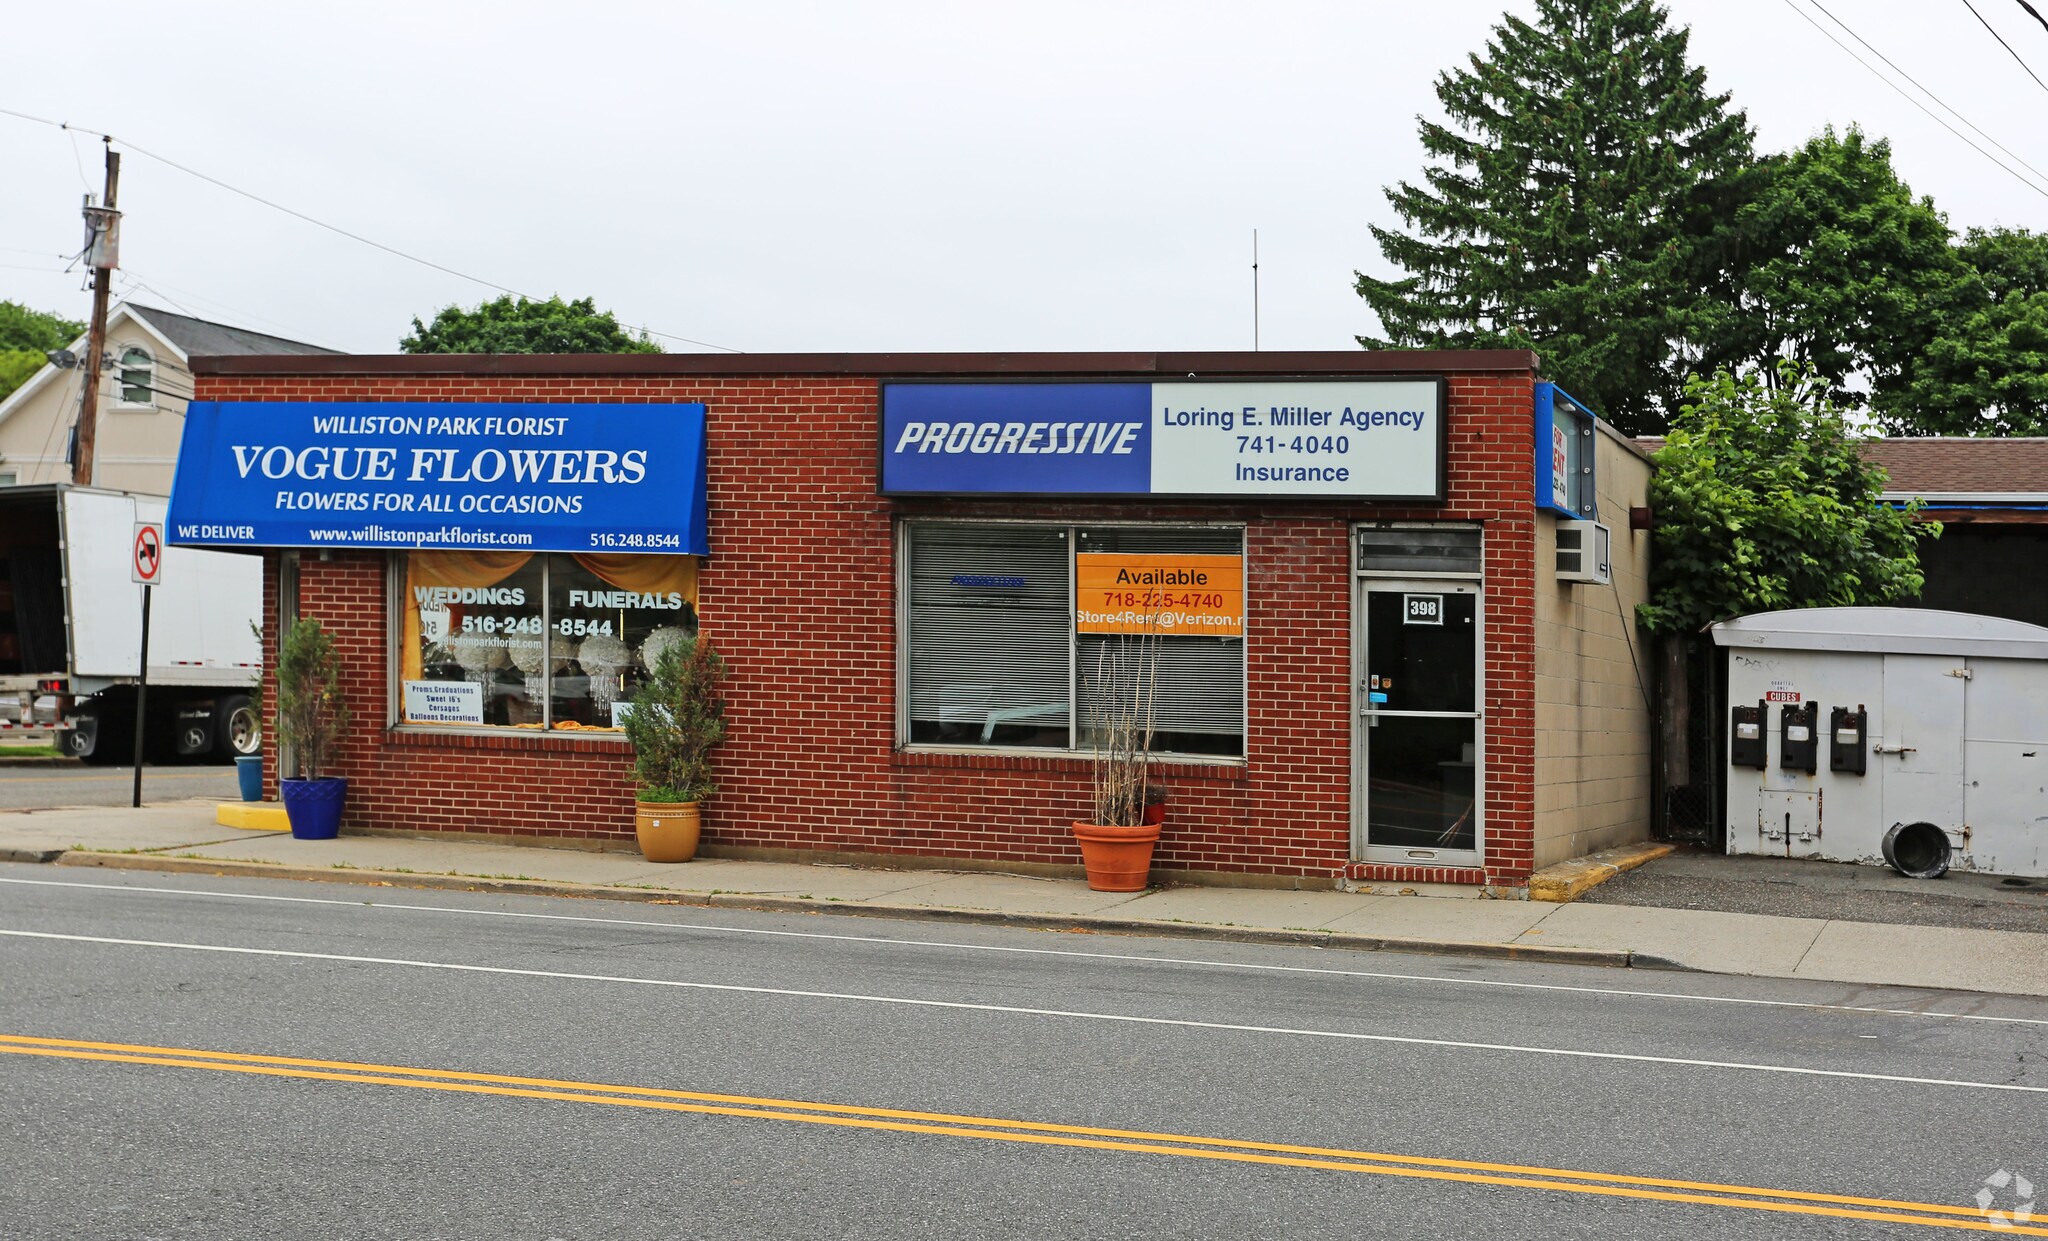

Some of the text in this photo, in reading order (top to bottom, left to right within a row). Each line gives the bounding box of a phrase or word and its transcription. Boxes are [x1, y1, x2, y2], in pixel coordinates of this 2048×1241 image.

[313, 416, 569, 436] WILLISTON PARK FLORIST
[1164, 407, 1425, 431] Loring E. Miller Agency
[894, 423, 1143, 454] PROGRESSIVE
[1236, 435, 1350, 454] 741-4040
[231, 445, 648, 484] VOGUE FLOWERS
[1553, 448, 1565, 477] ENT
[1235, 463, 1350, 482] Insurance
[275, 491, 583, 514] FLOWERS FOR ALL OCCASIONS
[178, 525, 255, 540] WE DELIVER
[309, 527, 532, 547] www.willistonparkflorist.com
[590, 533, 680, 547] 516.248.8544
[1116, 568, 1208, 586] Available
[414, 586, 525, 605] WEDDINGS
[569, 590, 682, 609] FUNERALS
[1104, 592, 1223, 609] 718-225-4740
[1410, 601, 1436, 616] 398
[426, 695, 446, 703] Sweet
[1771, 692, 1796, 702] CUBES
[429, 704, 460, 712] Corsages
